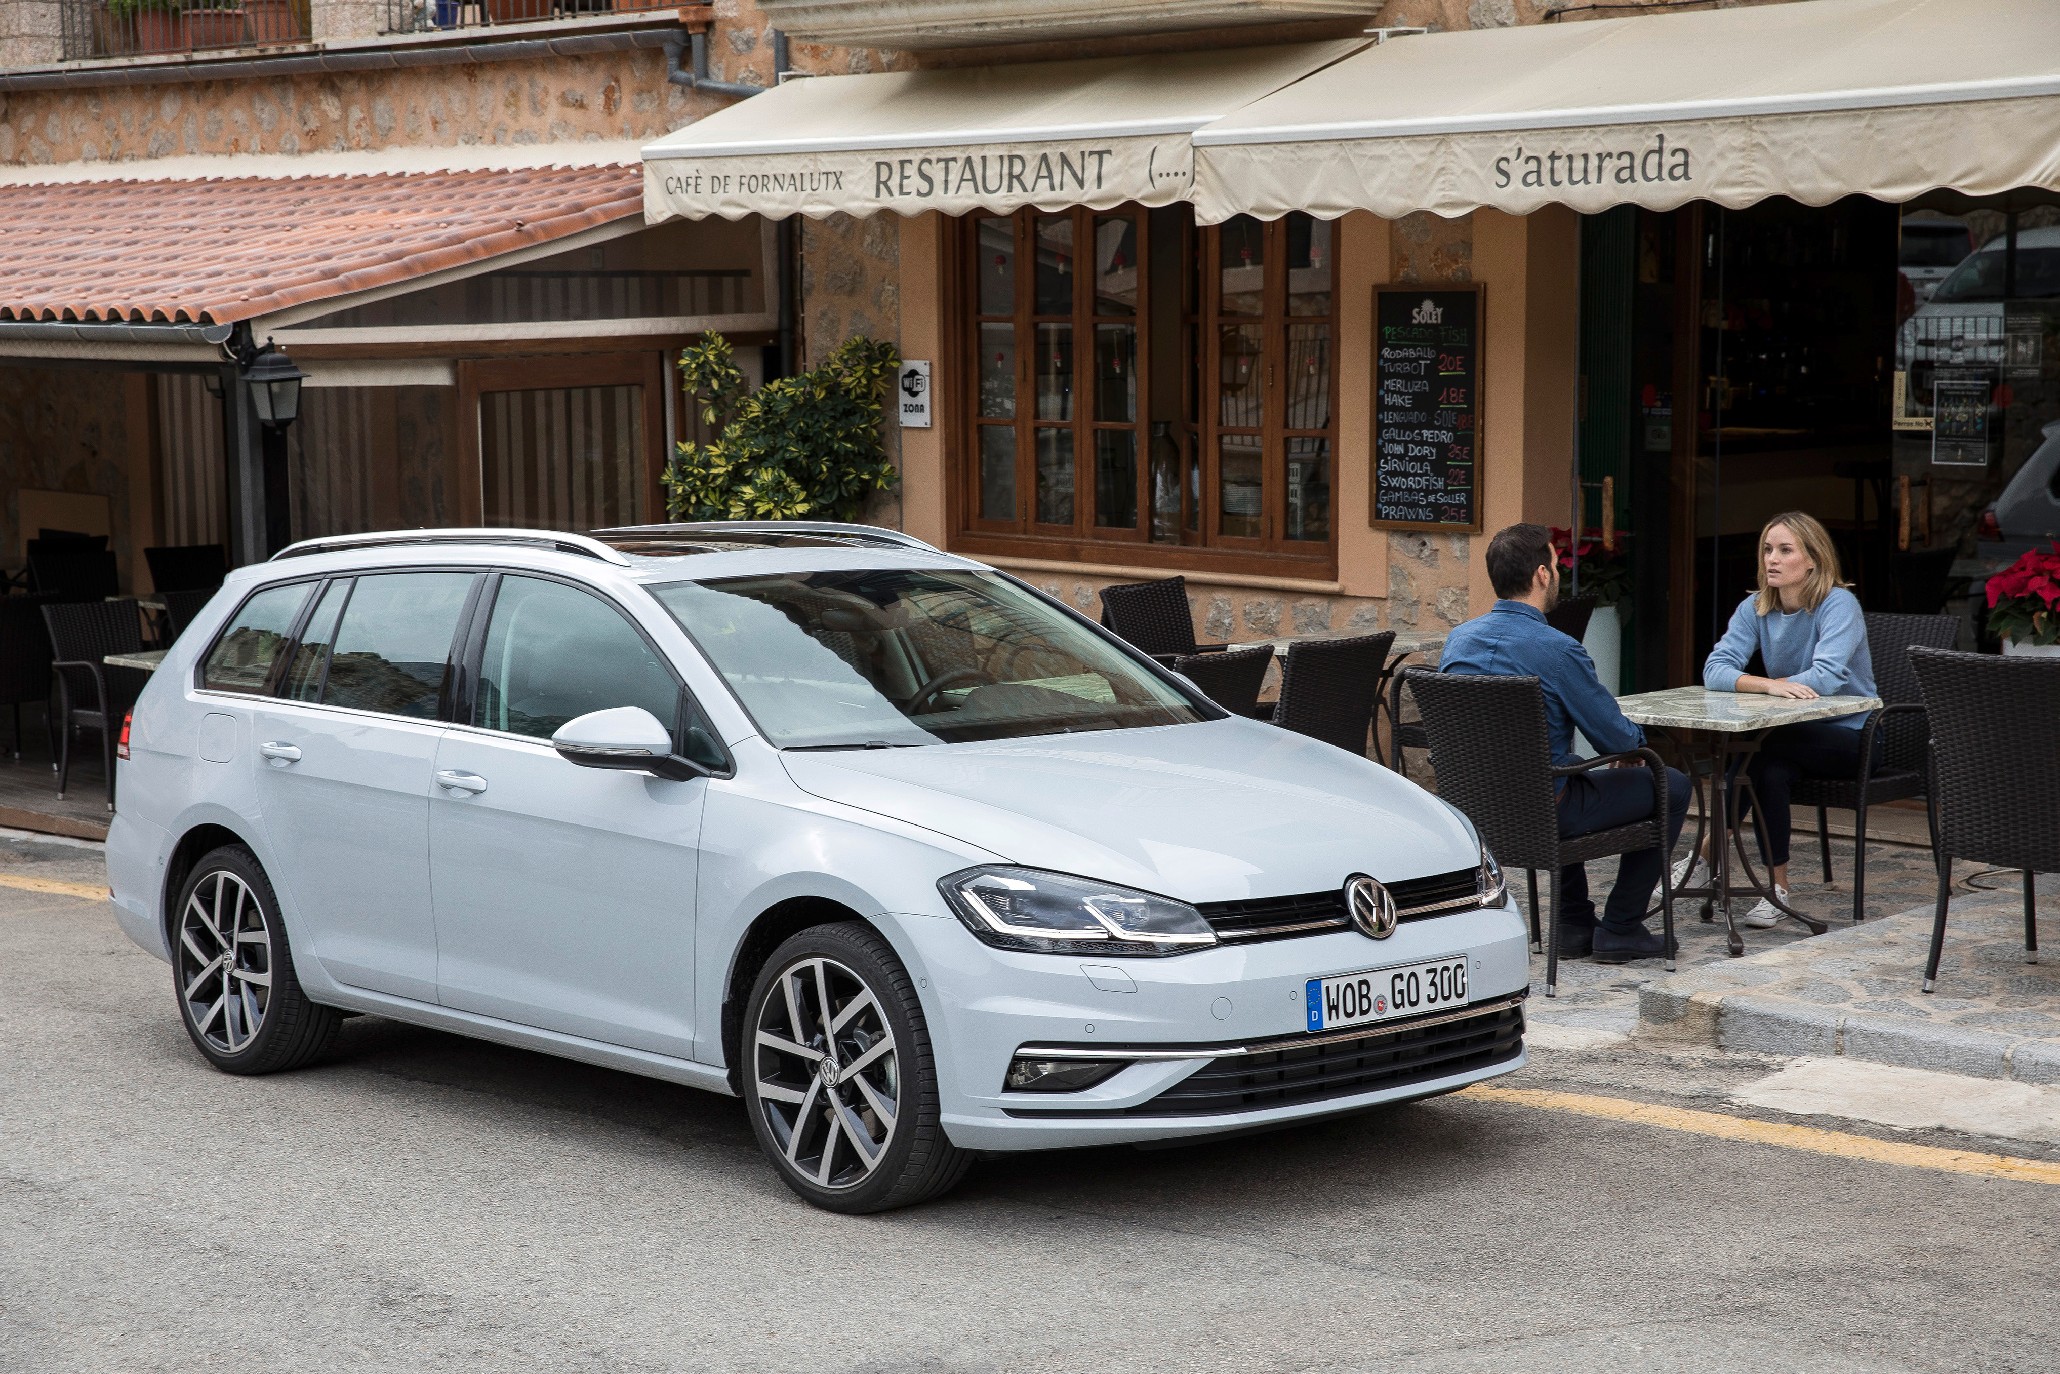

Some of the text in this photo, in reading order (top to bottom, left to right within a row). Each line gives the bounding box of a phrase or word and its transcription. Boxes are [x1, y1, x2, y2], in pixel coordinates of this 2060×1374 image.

[1495, 133, 1692, 189] s'aturada
[665, 169, 702, 195] CAFÈ
[711, 175, 731, 194] DE
[739, 171, 843, 194] FORNALUTX
[874, 149, 1112, 199] RESTAURANT
[1383, 360, 1430, 375] TURBOT
[1384, 379, 1429, 392] MERLUZA
[1384, 392, 1412, 407] HAKE
[903, 403, 925, 413] ZONA
[1434, 410, 1457, 427] SOLE
[1382, 443, 1405, 455] JOHN
[1408, 444, 1436, 459] DORY
[1379, 490, 1427, 504] GAMBAS
[1382, 506, 1434, 520] PRAWNS
[1311, 963, 1466, 1021] D WOB GO 300
